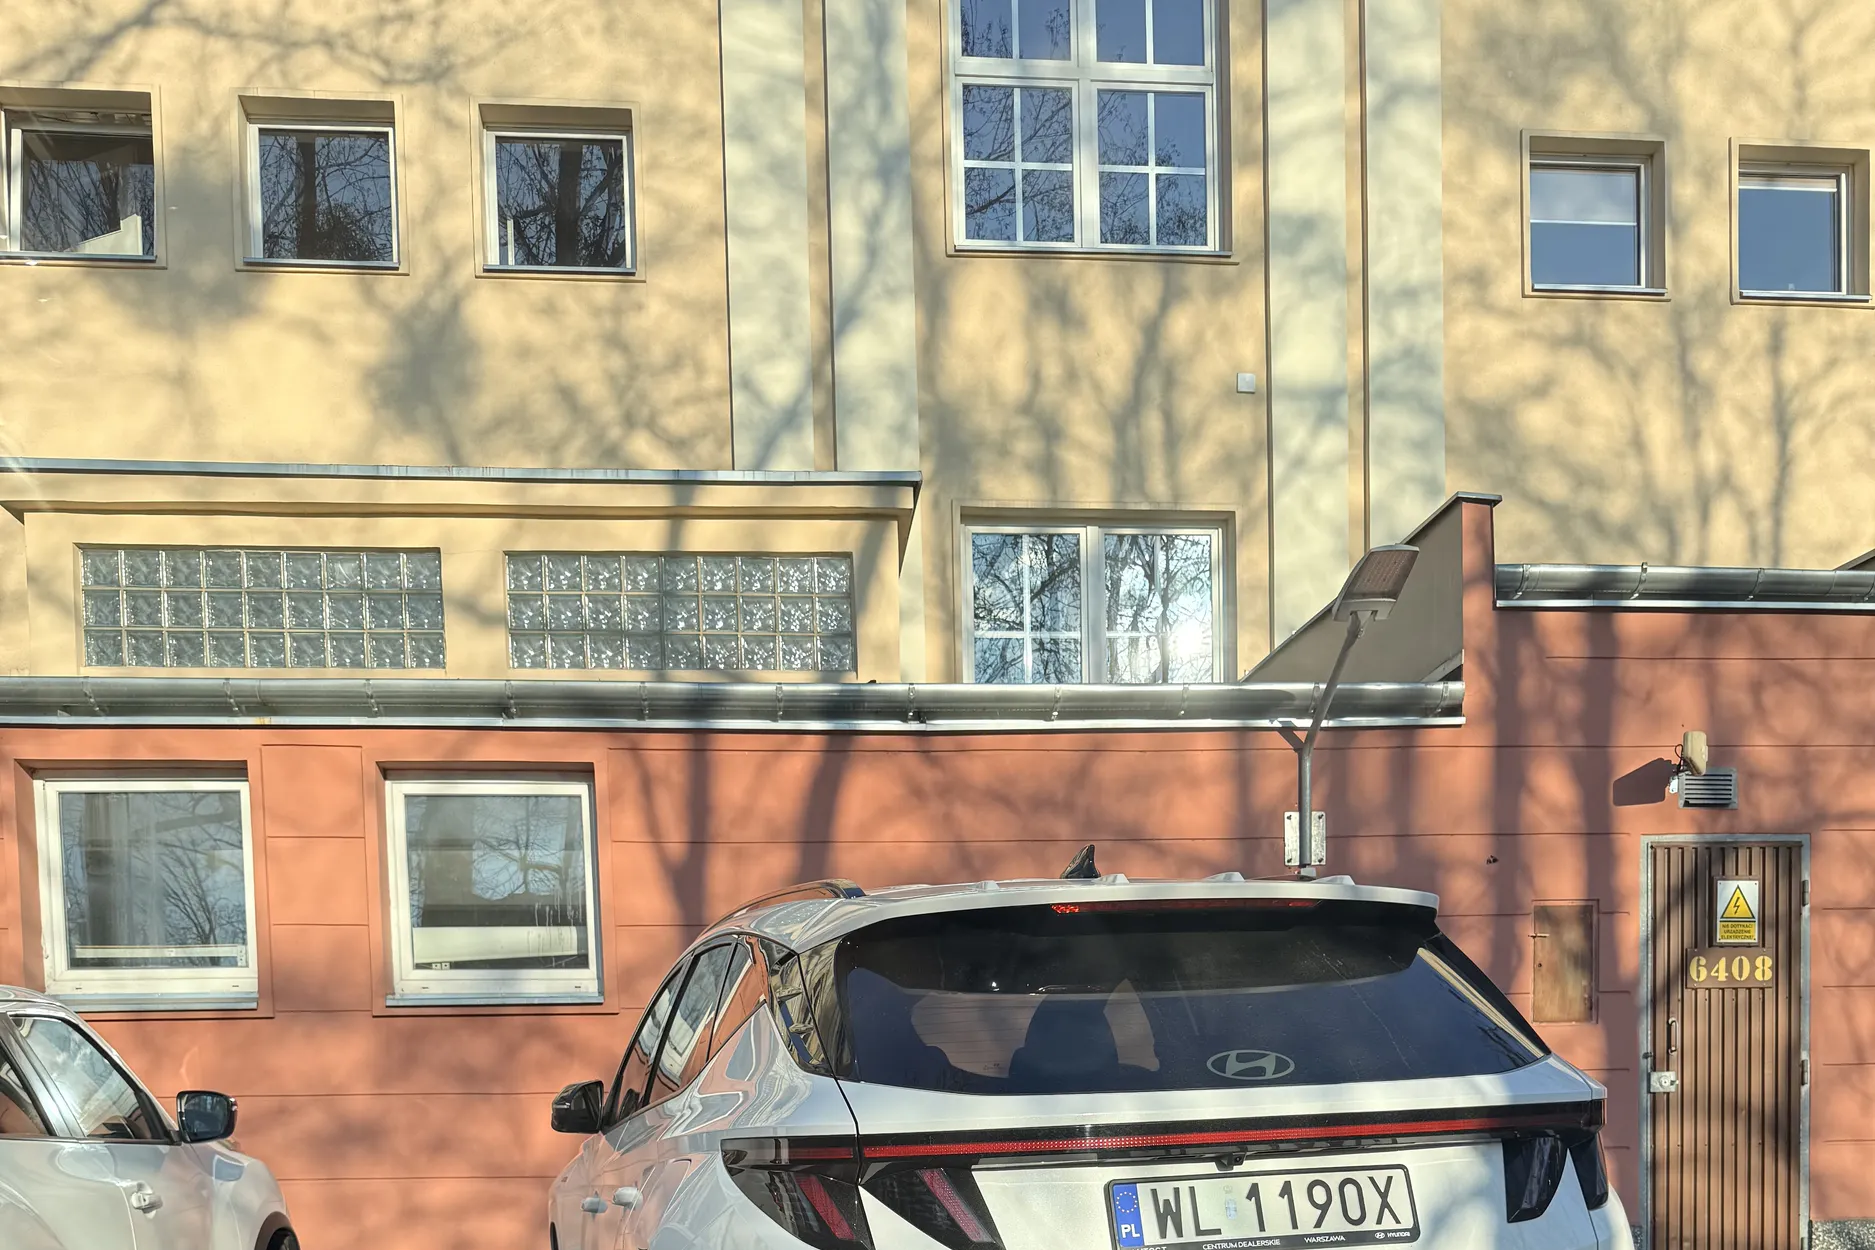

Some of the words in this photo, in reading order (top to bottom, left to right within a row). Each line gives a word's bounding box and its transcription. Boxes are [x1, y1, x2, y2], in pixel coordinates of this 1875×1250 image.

[1689, 955, 1773, 982] 6408
[1150, 1186, 1222, 1239] WL
[1245, 1175, 1402, 1233] 1190X
[1120, 1223, 1141, 1239] PL
[1304, 1235, 1346, 1243] WARSZAWA
[1202, 1242, 1238, 1250] CENTRUM
[1238, 1239, 1281, 1248] DEALERSKIE
